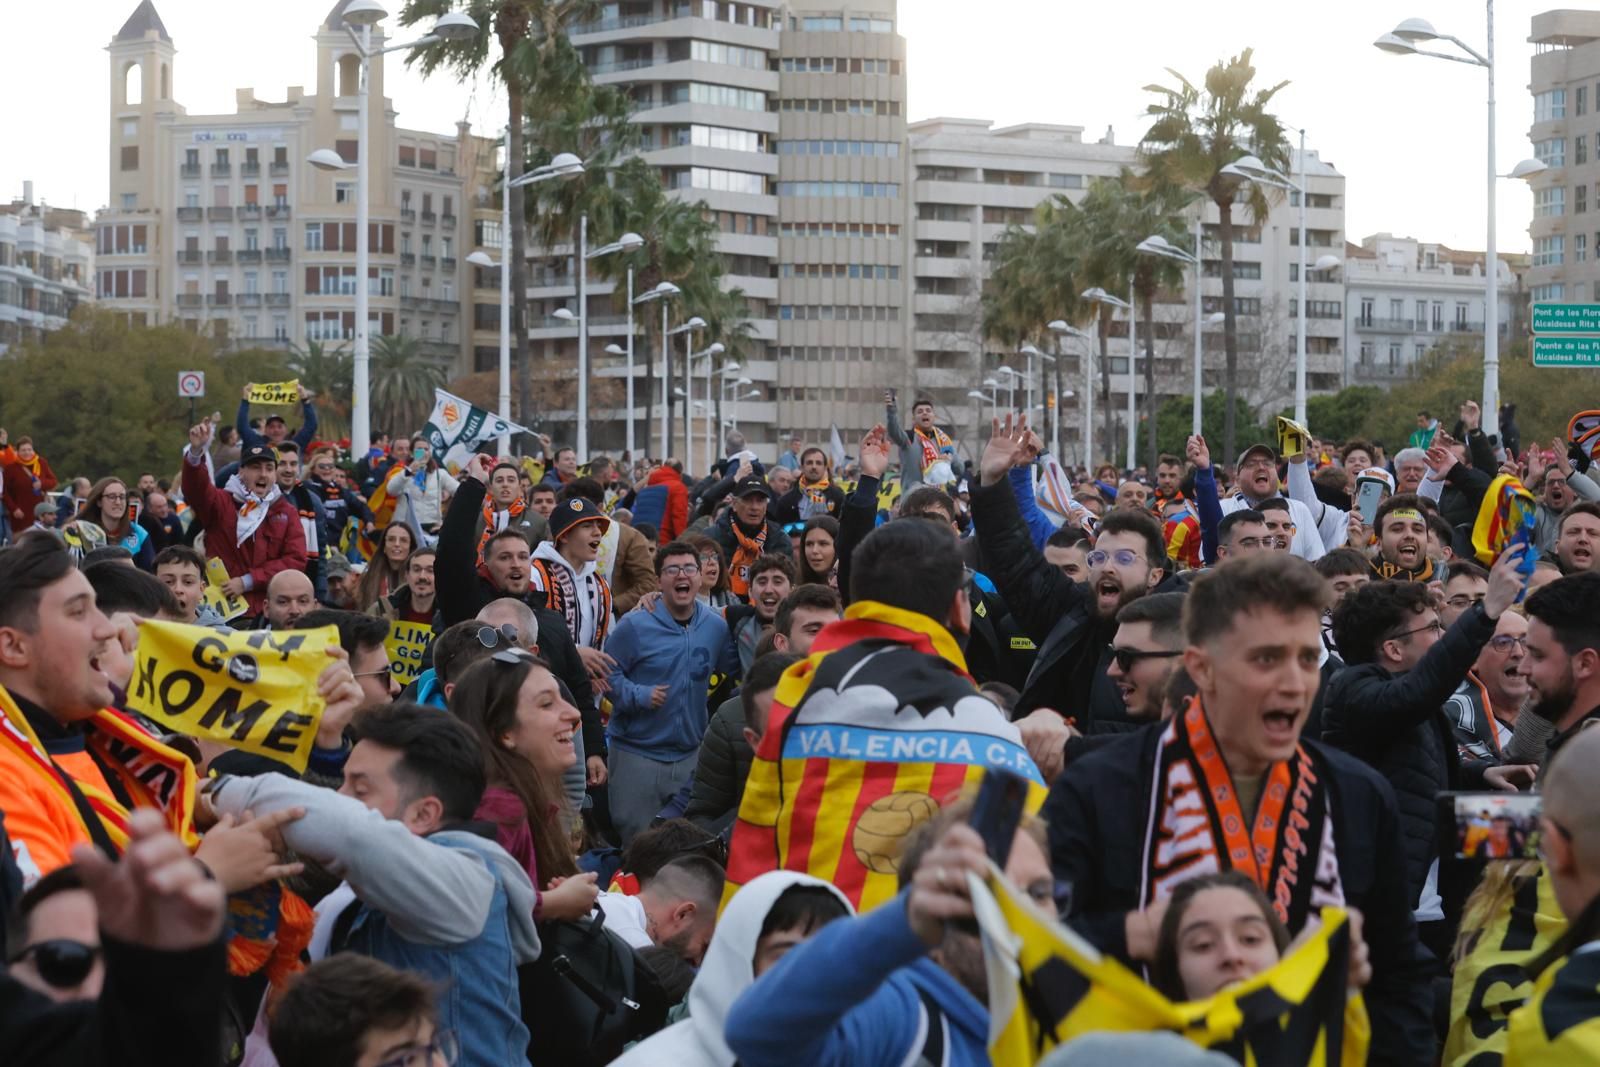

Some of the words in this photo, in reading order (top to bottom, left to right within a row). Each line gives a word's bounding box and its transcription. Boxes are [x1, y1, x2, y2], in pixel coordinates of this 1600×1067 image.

[1534, 308, 1552, 316] Pont
[1555, 308, 1565, 316] de
[1535, 320, 1576, 328] Alcaldessa
[1580, 320, 1595, 328] Rita
[1536, 341, 1562, 350] Puente
[1565, 342, 1575, 350] de
[1578, 342, 1589, 350] las
[1536, 353, 1573, 361] Alcaldesa
[1576, 352, 1592, 361] Rita
[250, 391, 297, 403] HOME
[394, 626, 430, 646] LIM
[135, 655, 314, 753] HOME
[801, 729, 975, 760] VALENCIA
